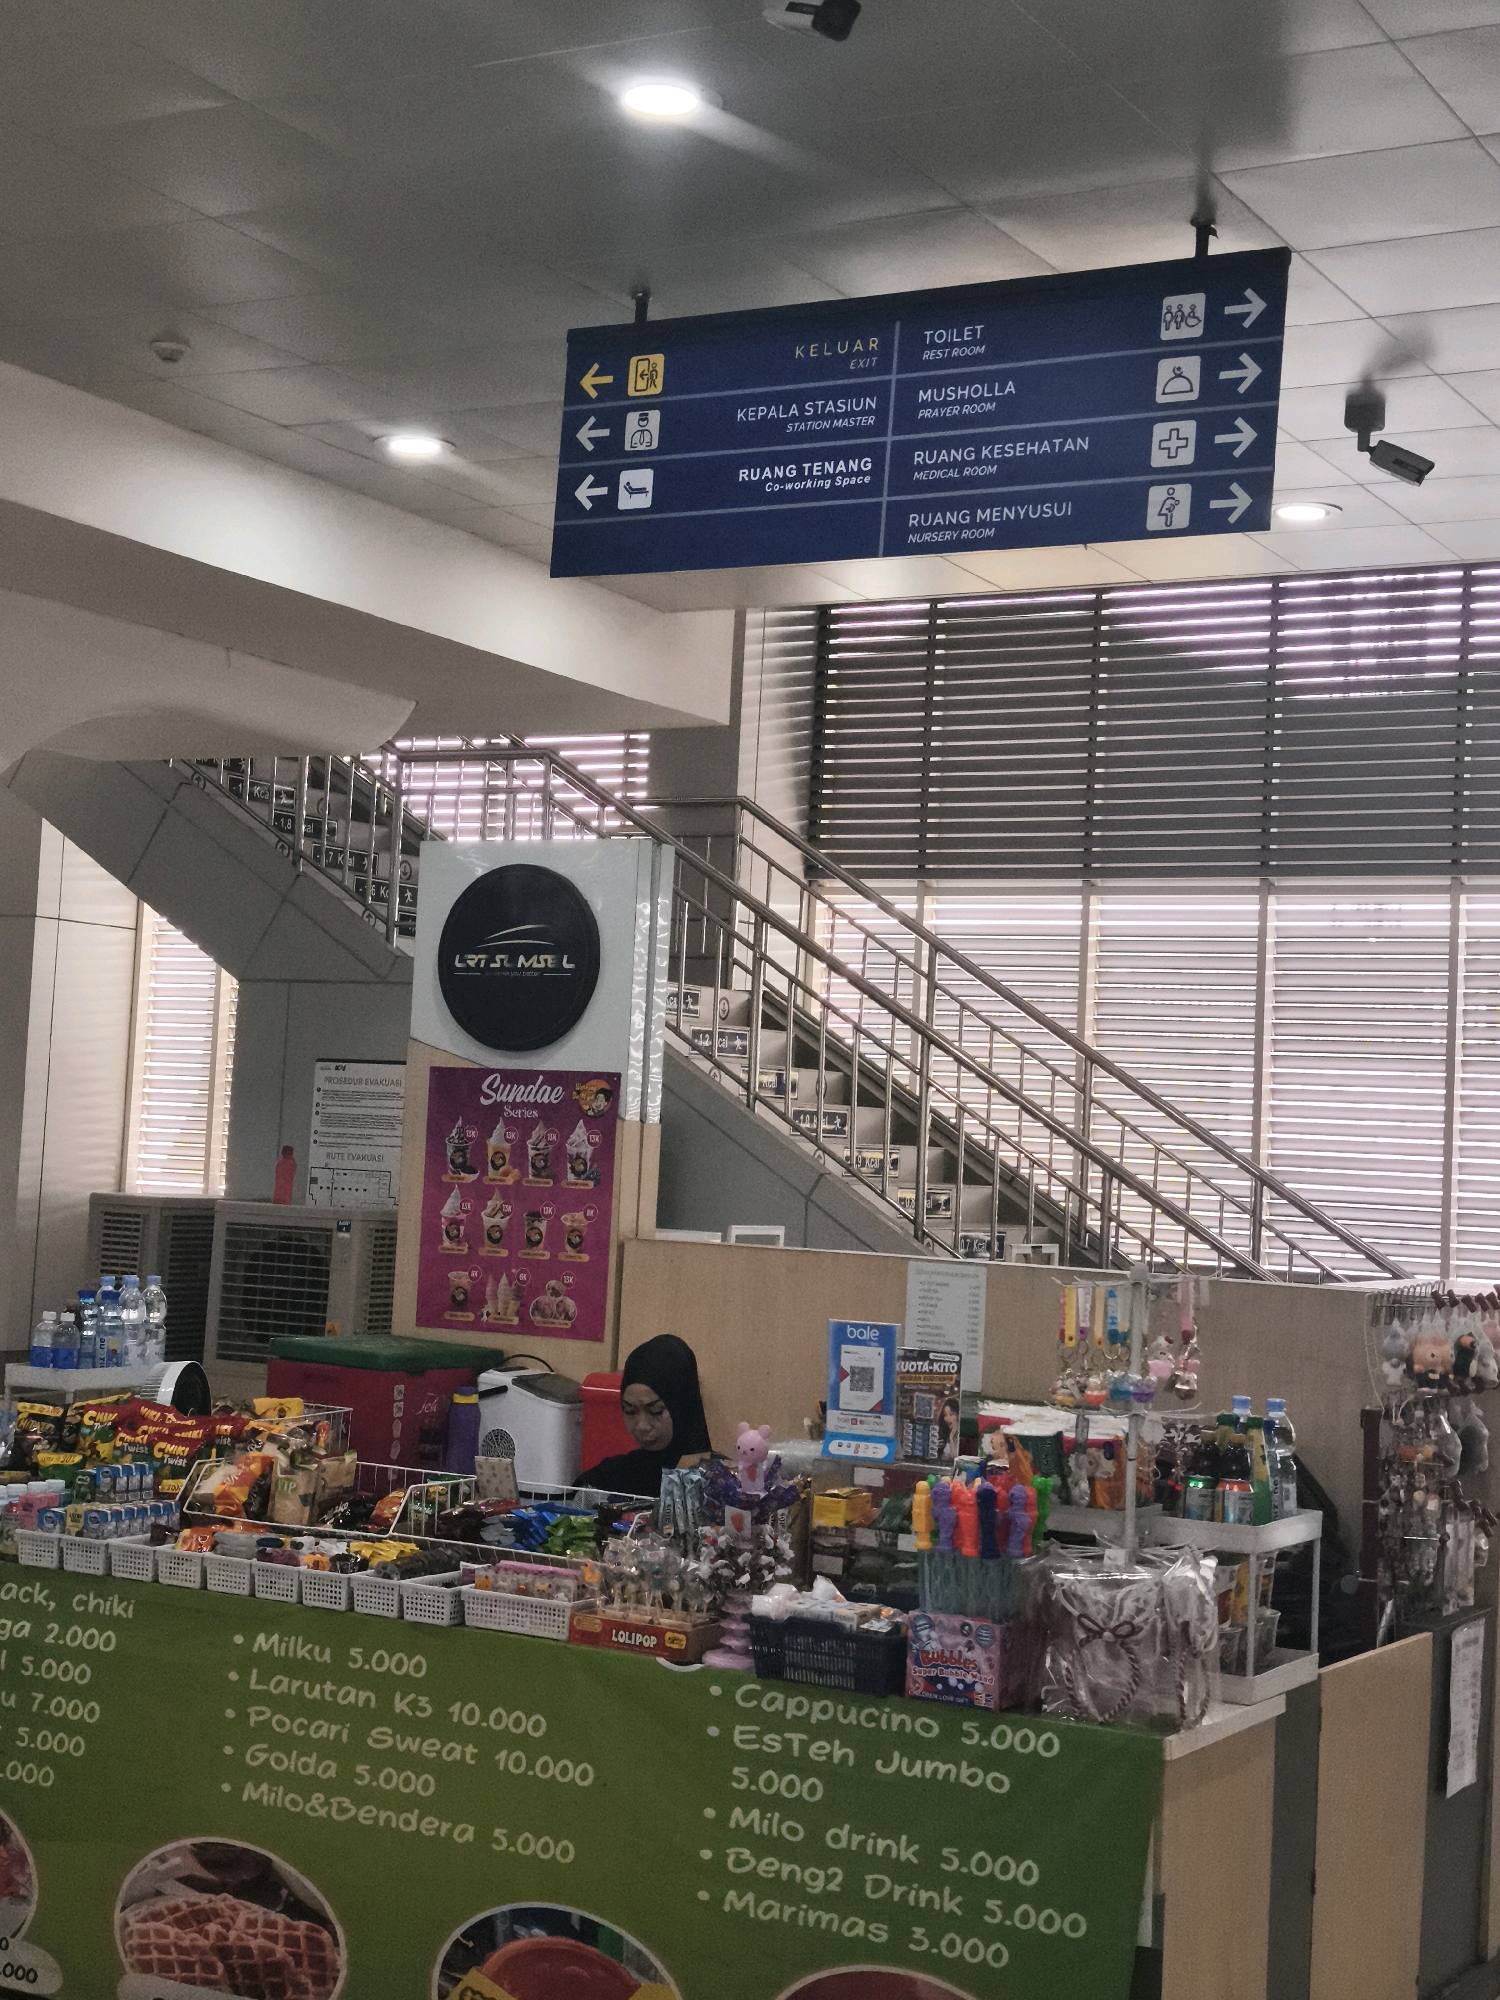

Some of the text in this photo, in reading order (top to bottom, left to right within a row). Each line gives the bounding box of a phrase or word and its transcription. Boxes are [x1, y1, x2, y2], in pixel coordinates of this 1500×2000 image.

[924, 325, 985, 345] TOILET
[795, 337, 880, 359] KELUAR
[922, 344, 985, 361] REST ROOM
[850, 356, 878, 370] EXIT
[918, 380, 1016, 403] MUSHOLLA
[737, 396, 877, 422] KEPALA STASIUN
[917, 401, 996, 420] PRAYER ROOM
[786, 415, 876, 433] STATION MASTER
[913, 436, 1090, 466] RUANG KESEHATAN
[739, 457, 873, 482] RUANG TENANG
[913, 464, 998, 482] MEDICAL ROOM
[765, 473, 871, 493] Co-working Space
[908, 502, 1072, 528] RUANG MENYUSUI
[907, 527, 995, 544] NURSERY ROOM
[454, 954, 489, 968] LRT
[364, 1077, 402, 1087] EVAKUASI
[480, 1073, 565, 1106] Sundae
[503, 1105, 539, 1118] Series
[347, 1153, 384, 1163] EVAKUASI
[847, 1325, 879, 1340] bale
[123, 1443, 149, 1455] Twist
[153, 1441, 190, 1459] CHIKI
[163, 1454, 188, 1467] Twist
[0, 1582, 134, 1618] ack, chiki
[44, 1623, 116, 1652] 2.000
[612, 1629, 657, 1648] LOLIPOP
[252, 1632, 427, 1678] Milku 5.000
[920, 1649, 978, 1671] Bubbles
[21, 1655, 92, 1684] 5.000
[912, 1666, 994, 1685] Super Bubble Wand
[31, 1691, 100, 1723] 7.000
[250, 1669, 547, 1738] Larutan K3 10.000
[735, 1683, 1060, 1758] Cappucino 5.000
[15, 1727, 85, 1757] 5.000
[247, 1705, 595, 1787] Pocari Sweat 10.000
[245, 1743, 436, 1797] Golda 5.000
[734, 1725, 1010, 1794] EsTeh Jumbo
[731, 1767, 824, 1802] 5.000
[242, 1781, 576, 1864] Milo&Bendera 5.000
[729, 1806, 1040, 1887] Milo drink 5.000
[726, 1847, 1088, 1939] Beng2 Drink 5.000
[723, 1889, 1010, 1969] Marimas 3.000
